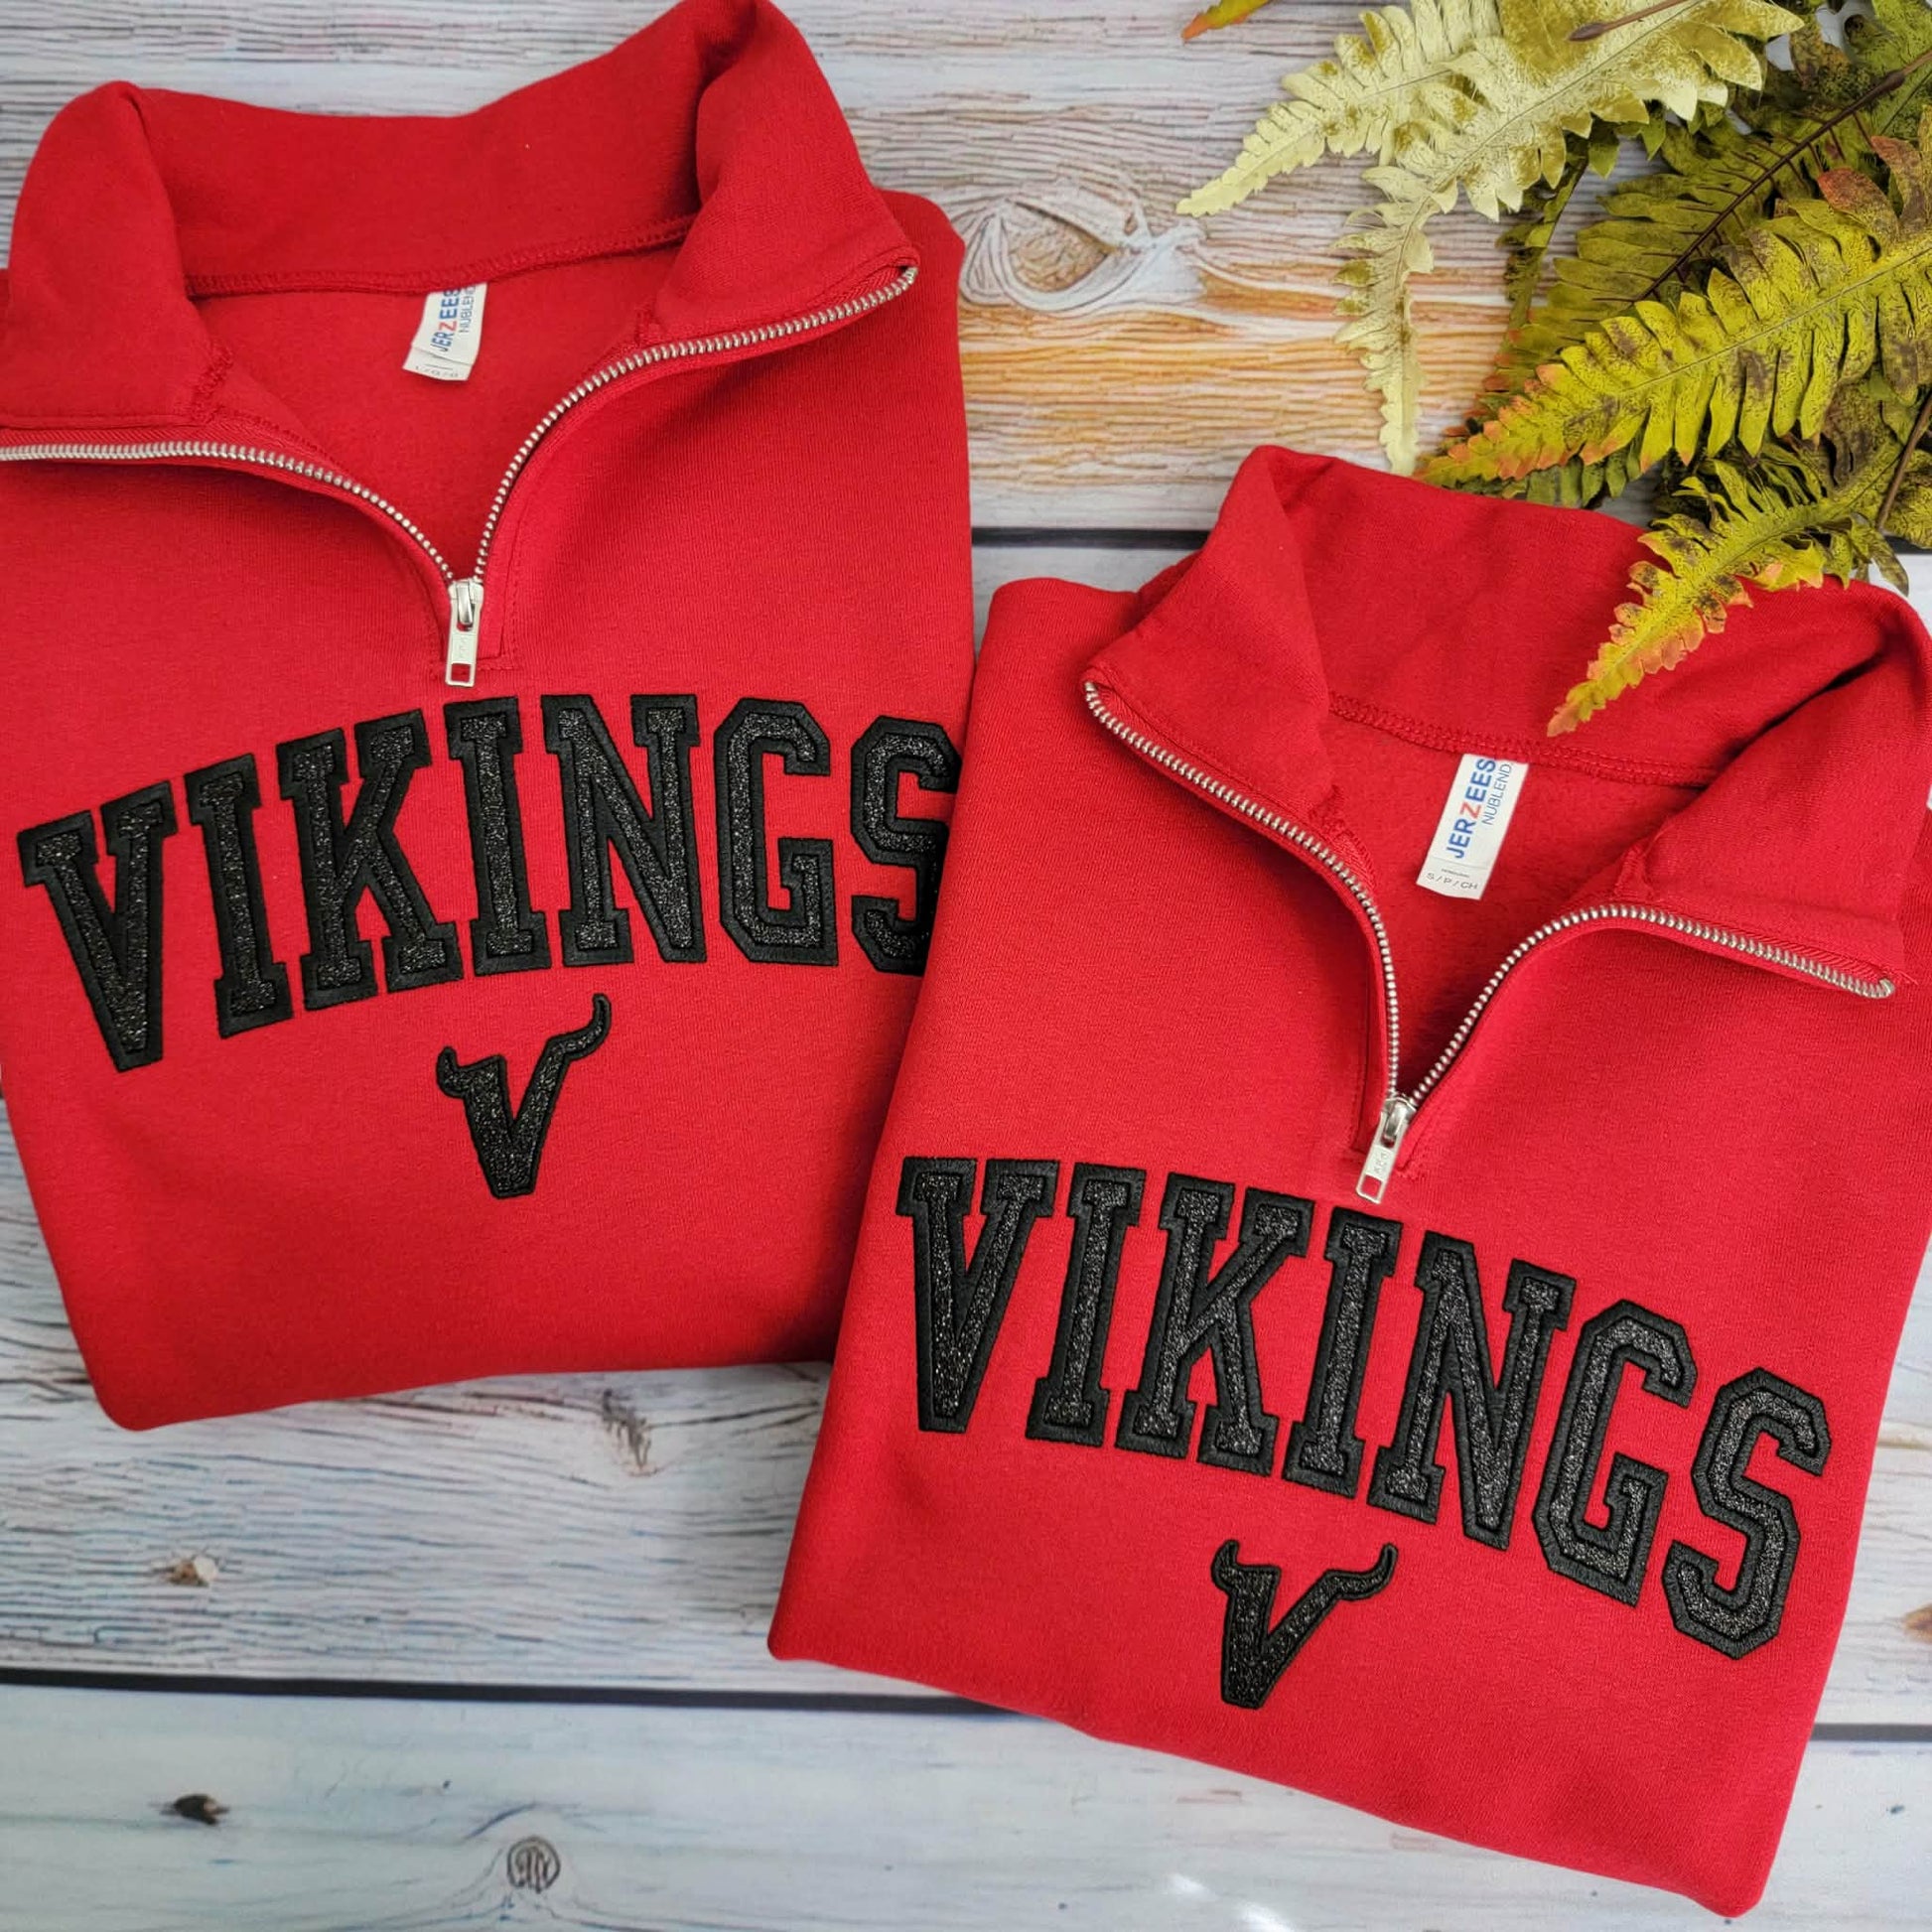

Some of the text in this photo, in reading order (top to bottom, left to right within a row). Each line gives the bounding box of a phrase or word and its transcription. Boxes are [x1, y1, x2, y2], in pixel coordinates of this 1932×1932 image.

[17, 694, 962, 1072] VIKINGS
[1446, 759, 1496, 859] JERZEES
[896, 1157, 1832, 1660] VIKINGS
